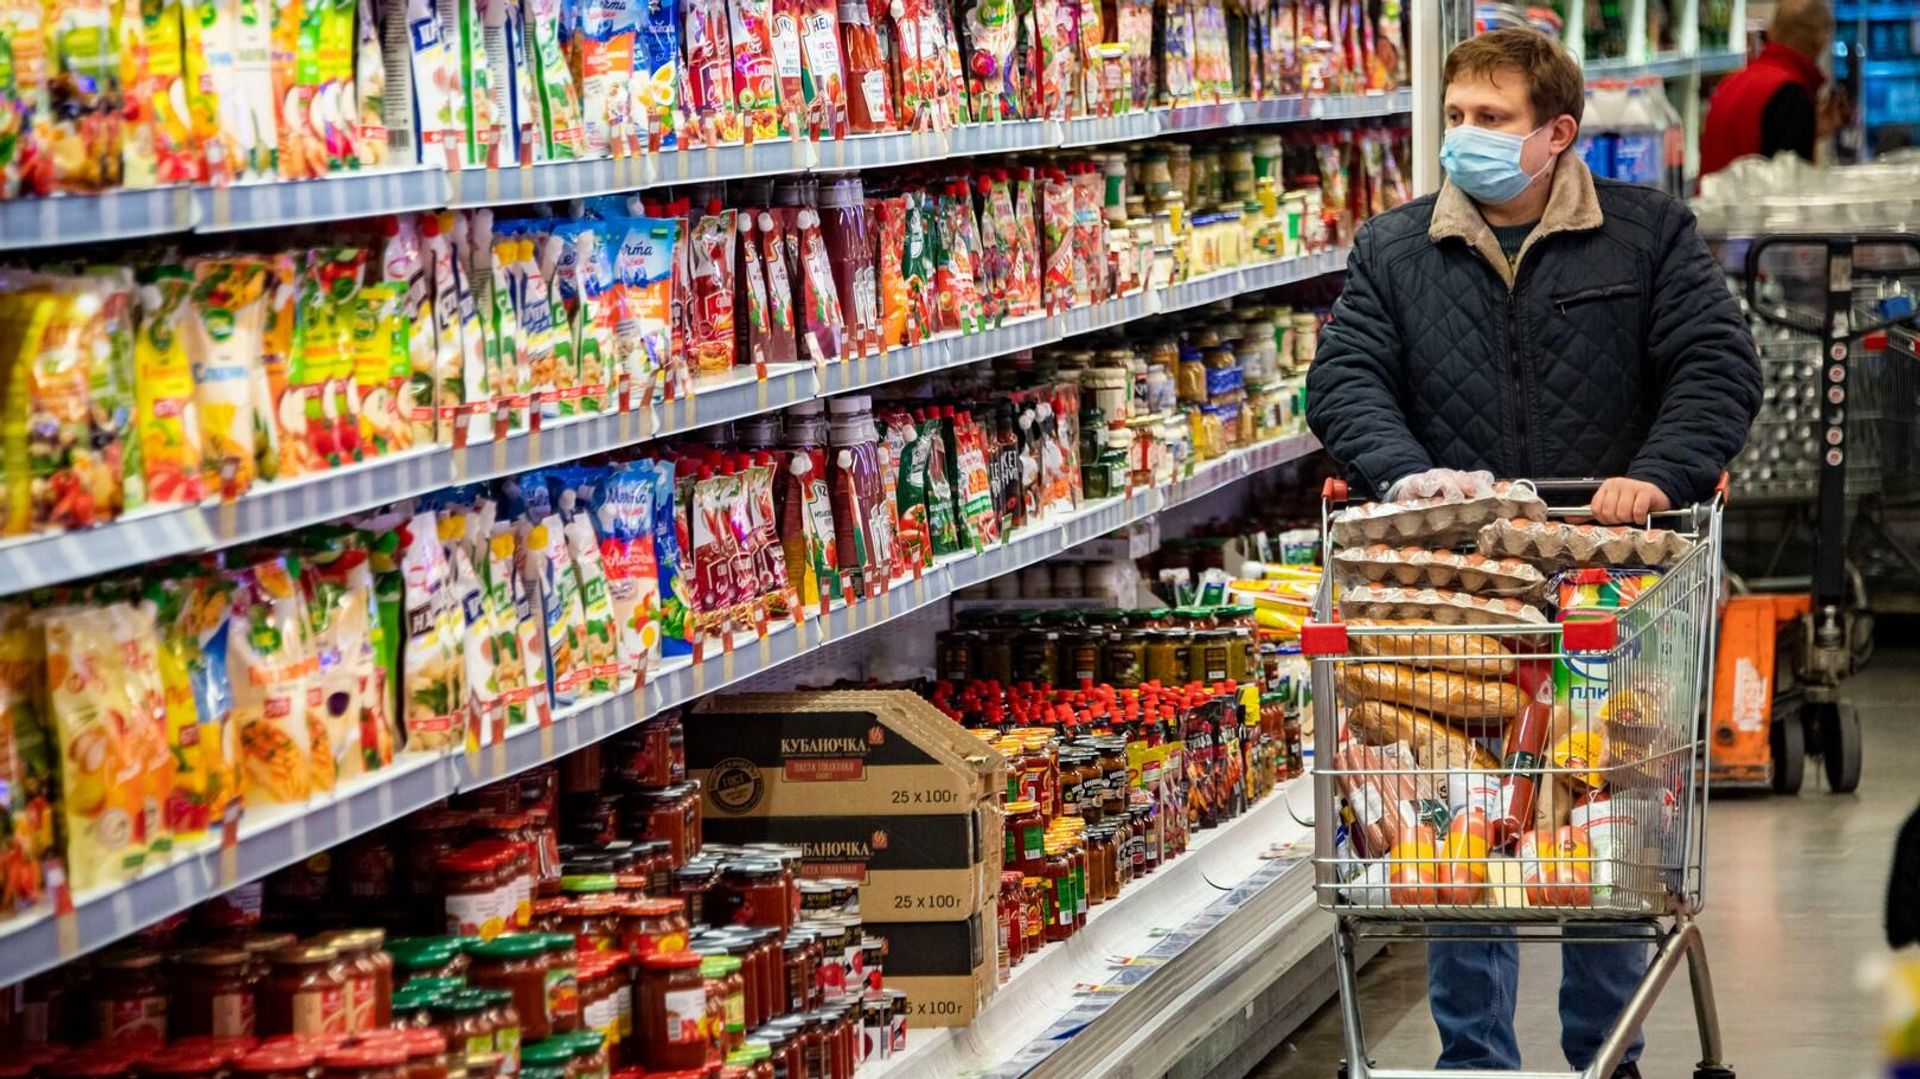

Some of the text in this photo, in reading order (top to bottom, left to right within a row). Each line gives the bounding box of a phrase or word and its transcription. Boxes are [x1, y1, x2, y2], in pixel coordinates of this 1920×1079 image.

[781, 738, 867, 753] КУБАНОЧКА
[892, 790, 909, 804] 25
[784, 842, 870, 857] БАНОЧКА
[801, 863, 819, 875] АСТА
[894, 895, 912, 909] 25
